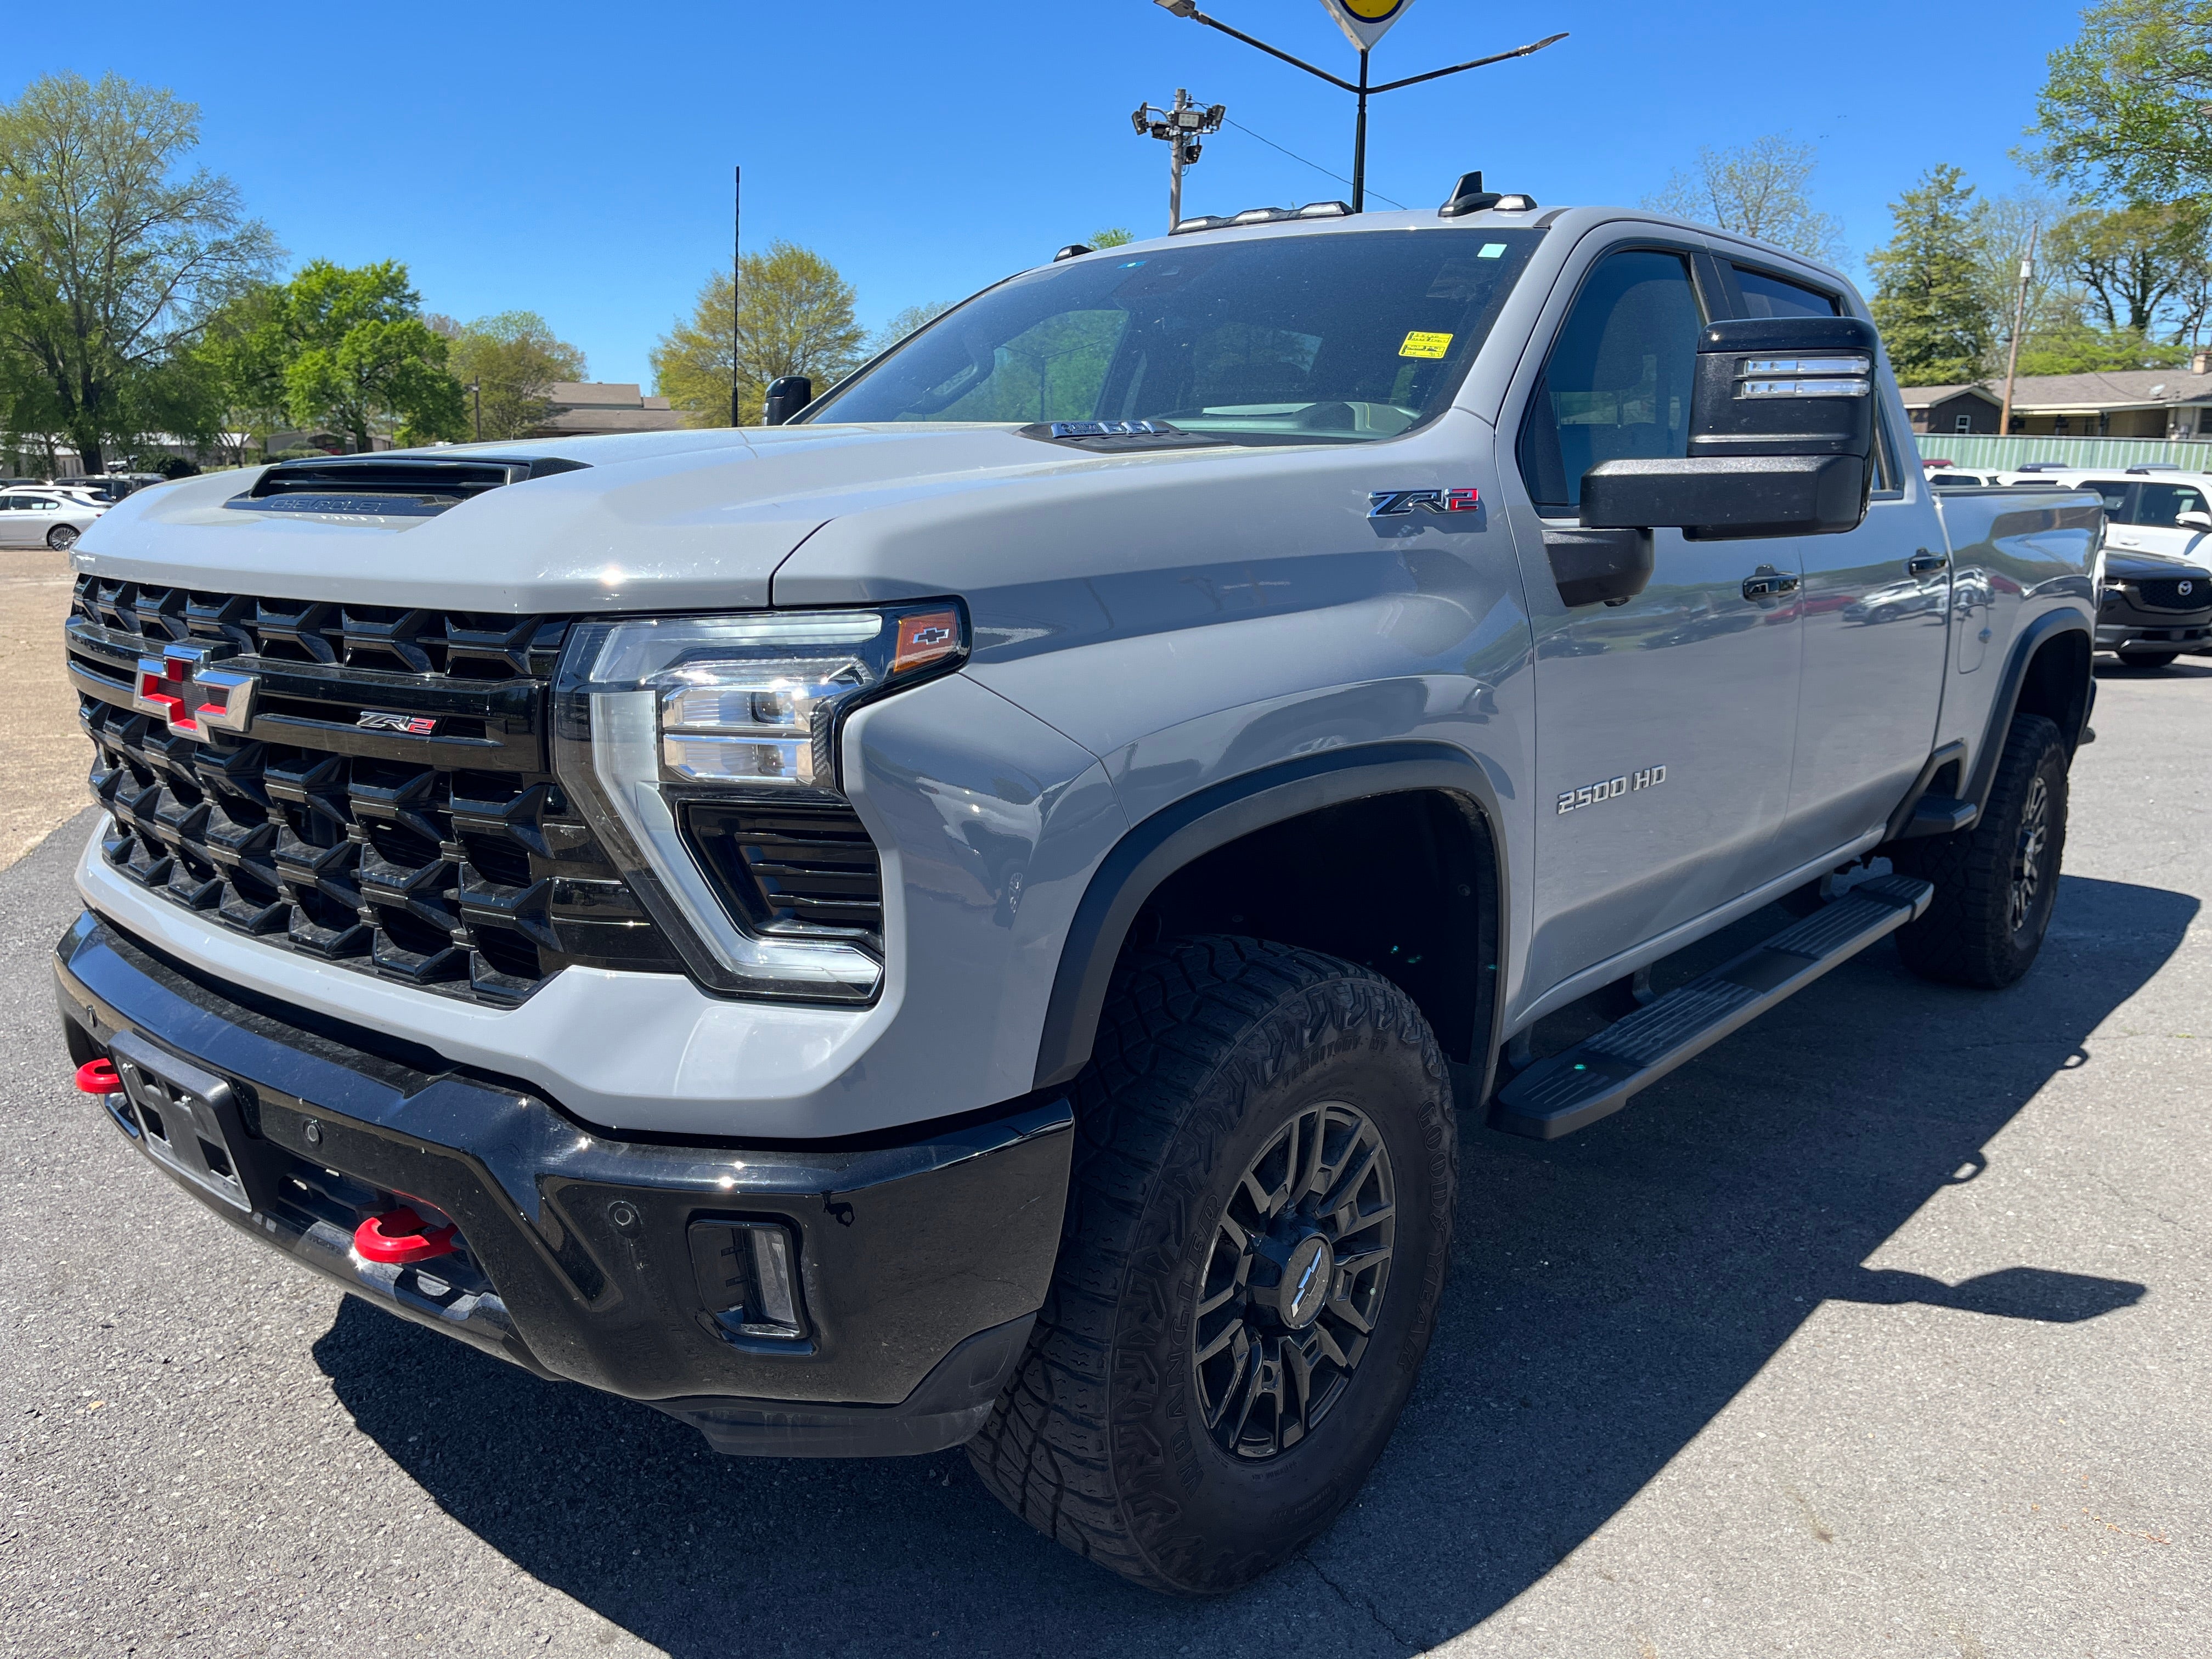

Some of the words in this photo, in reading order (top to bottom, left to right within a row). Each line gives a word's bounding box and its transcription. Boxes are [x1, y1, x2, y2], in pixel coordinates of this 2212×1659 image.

[270, 498, 390, 512] CHEVROLET
[1366, 488, 1479, 519] ZR2
[356, 710, 437, 736] ZR2
[1556, 775, 1627, 815] 2500
[1632, 764, 1667, 792] HD
[1282, 1035, 1362, 1088] TERRITORY
[1168, 1194, 1220, 1501] WRANGLER
